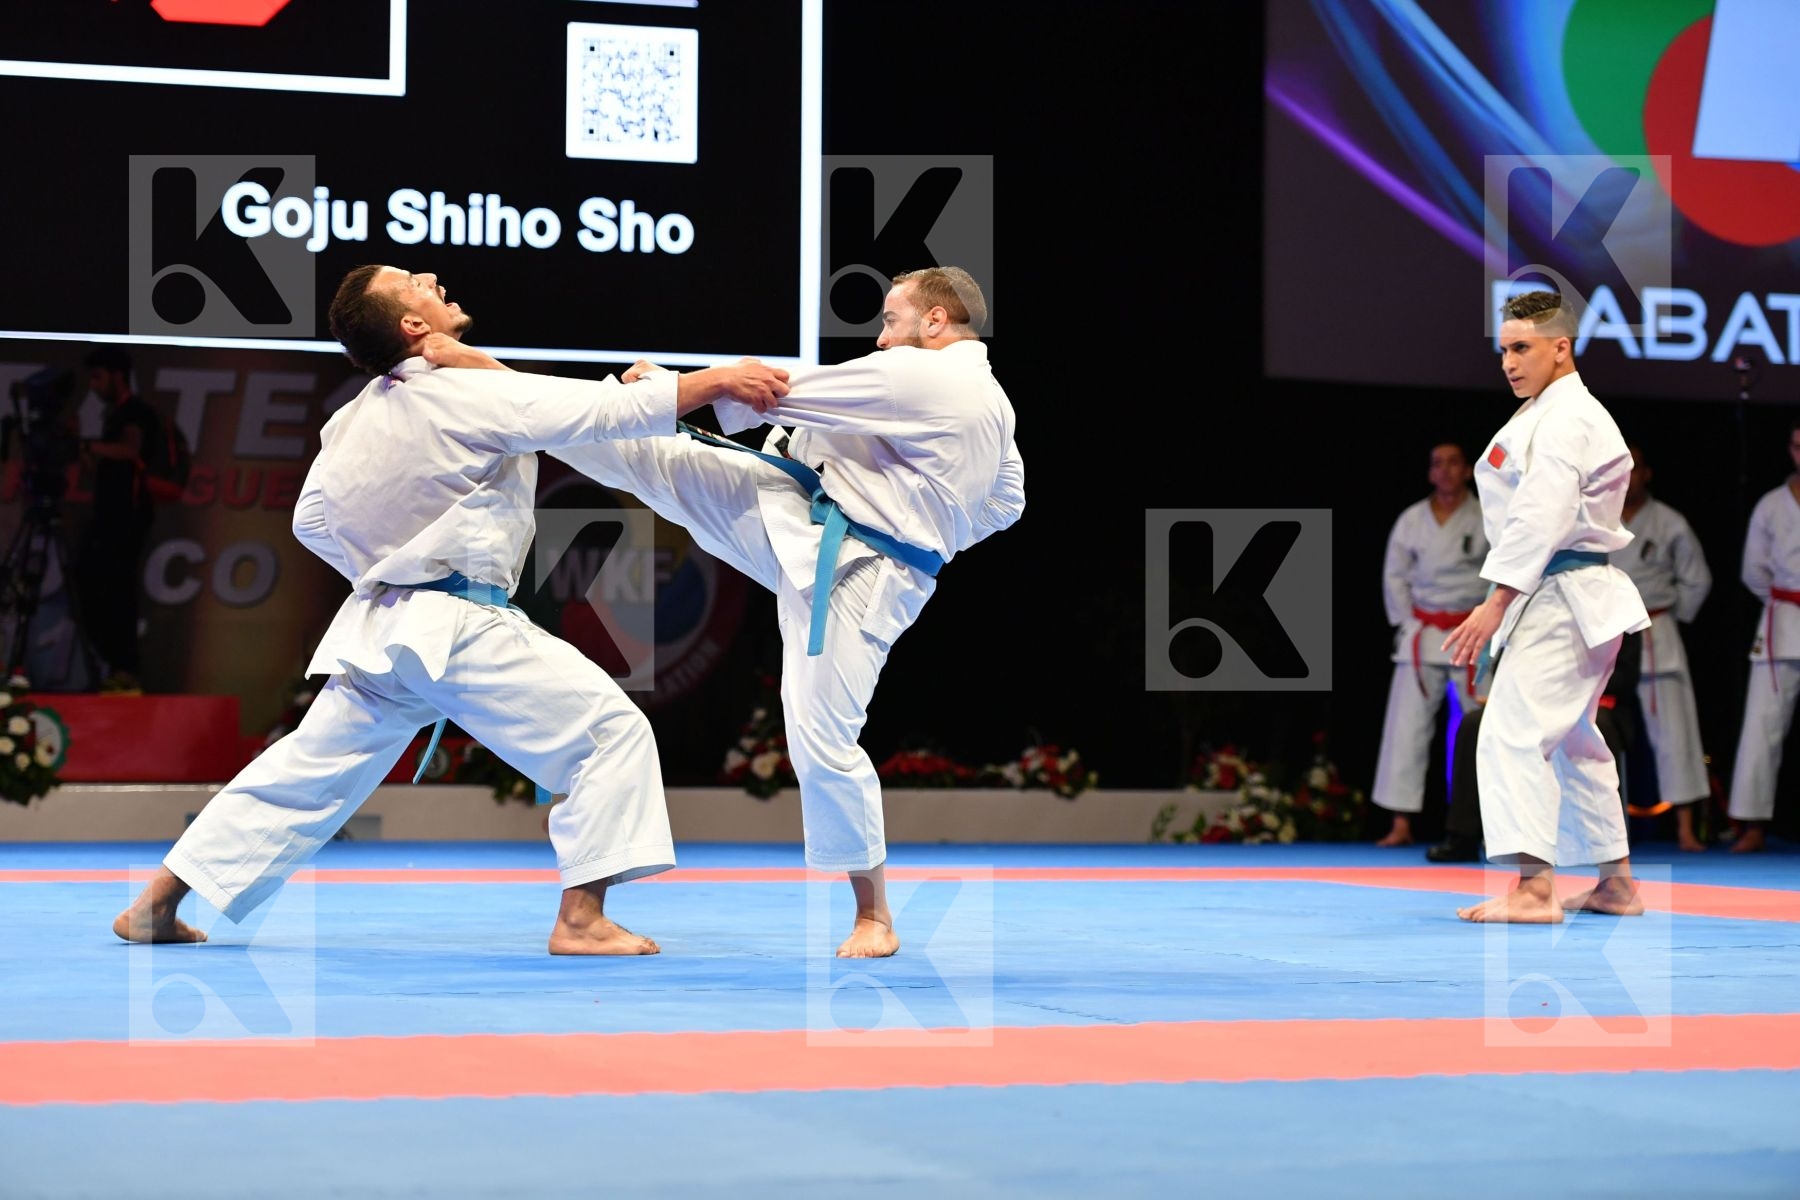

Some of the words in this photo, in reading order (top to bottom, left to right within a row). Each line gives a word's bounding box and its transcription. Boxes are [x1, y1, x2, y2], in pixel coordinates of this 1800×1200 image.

[221, 181, 369, 253] Goju
[385, 188, 562, 249] Shiho
[577, 197, 695, 255] Sho
[545, 546, 674, 604] WKF
